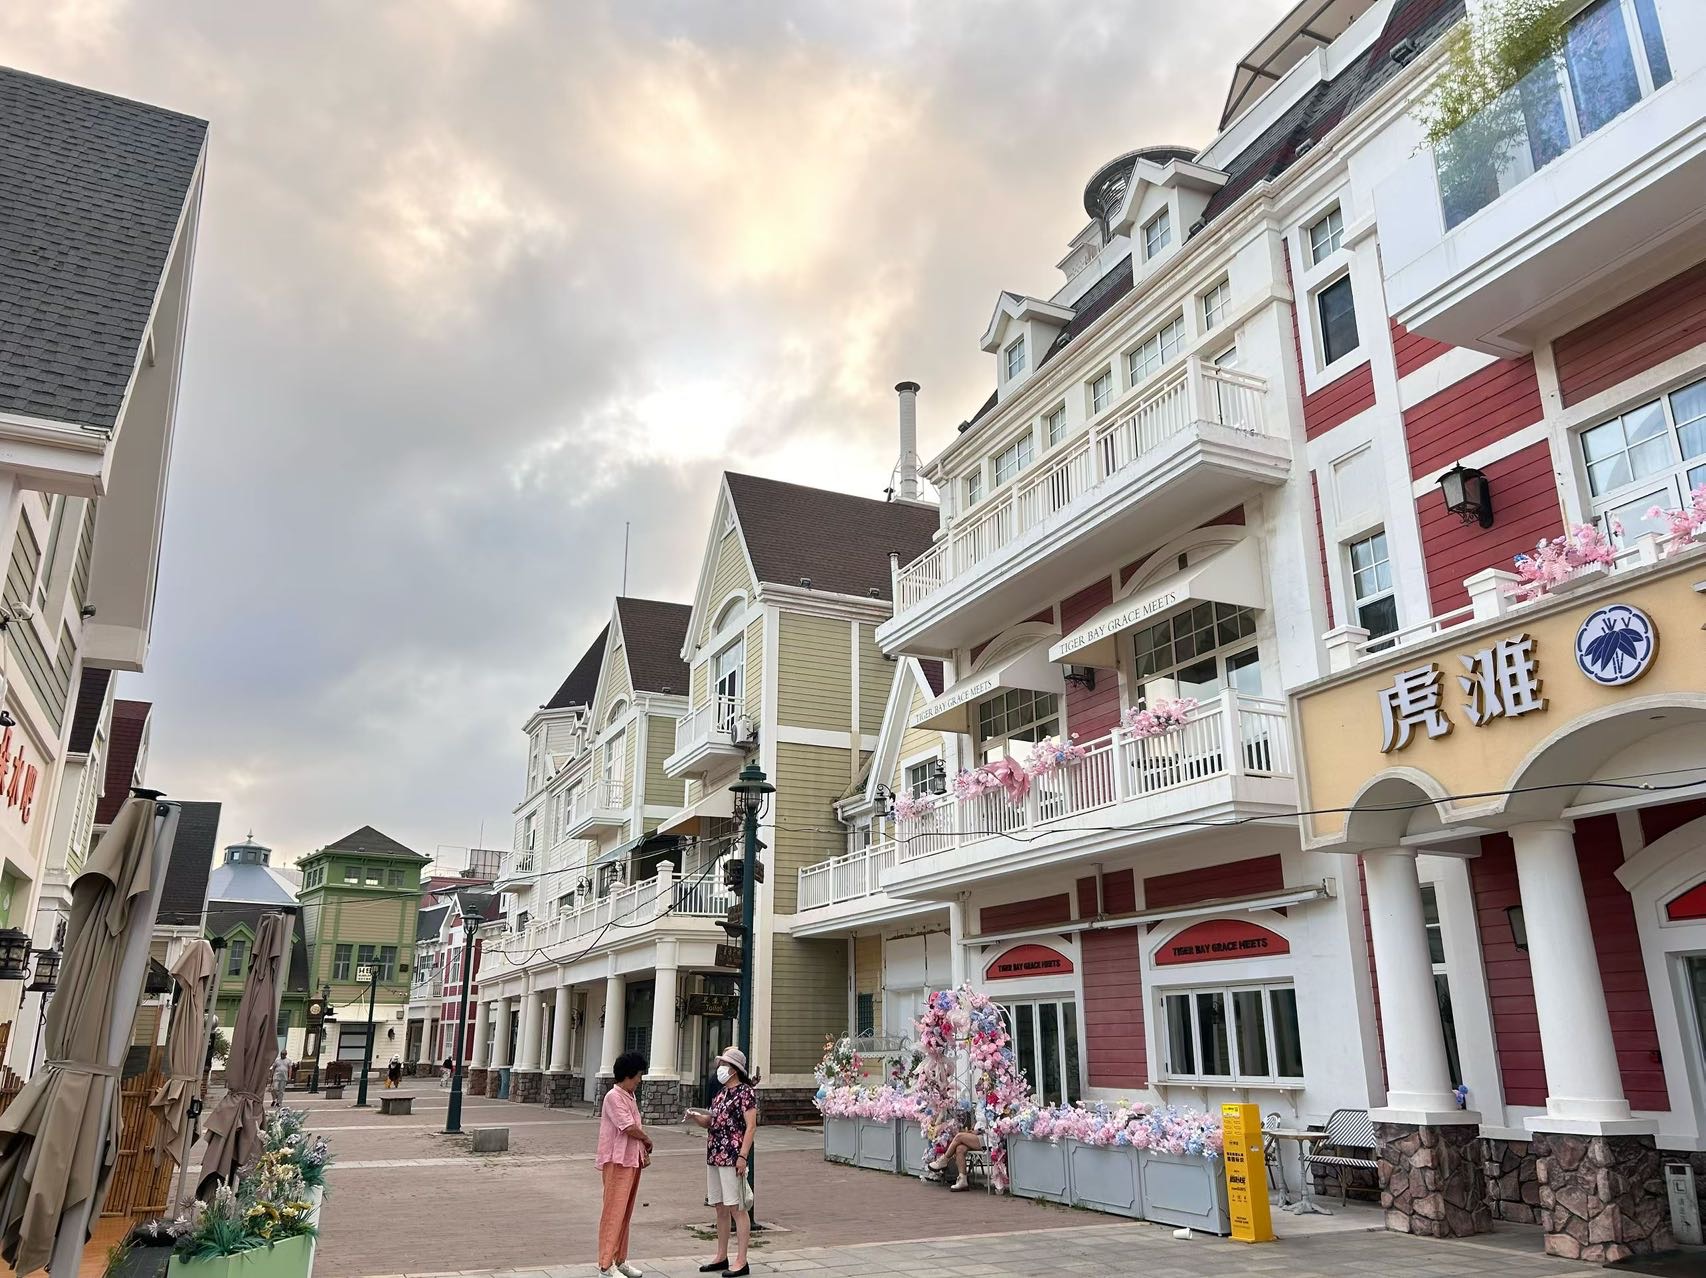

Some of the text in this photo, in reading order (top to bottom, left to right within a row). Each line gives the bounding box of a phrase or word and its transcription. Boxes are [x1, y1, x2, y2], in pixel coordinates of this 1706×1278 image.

[1059, 591, 1177, 655] TIGER BAY GRACE MEETS
[916, 679, 992, 723] TIGER BAY GRACE MEETS
[1377, 633, 1549, 754] 虎滩
[1172, 946, 1194, 956] TIGER
[1194, 944, 1210, 954] BAY
[1211, 941, 1238, 952] GRACE
